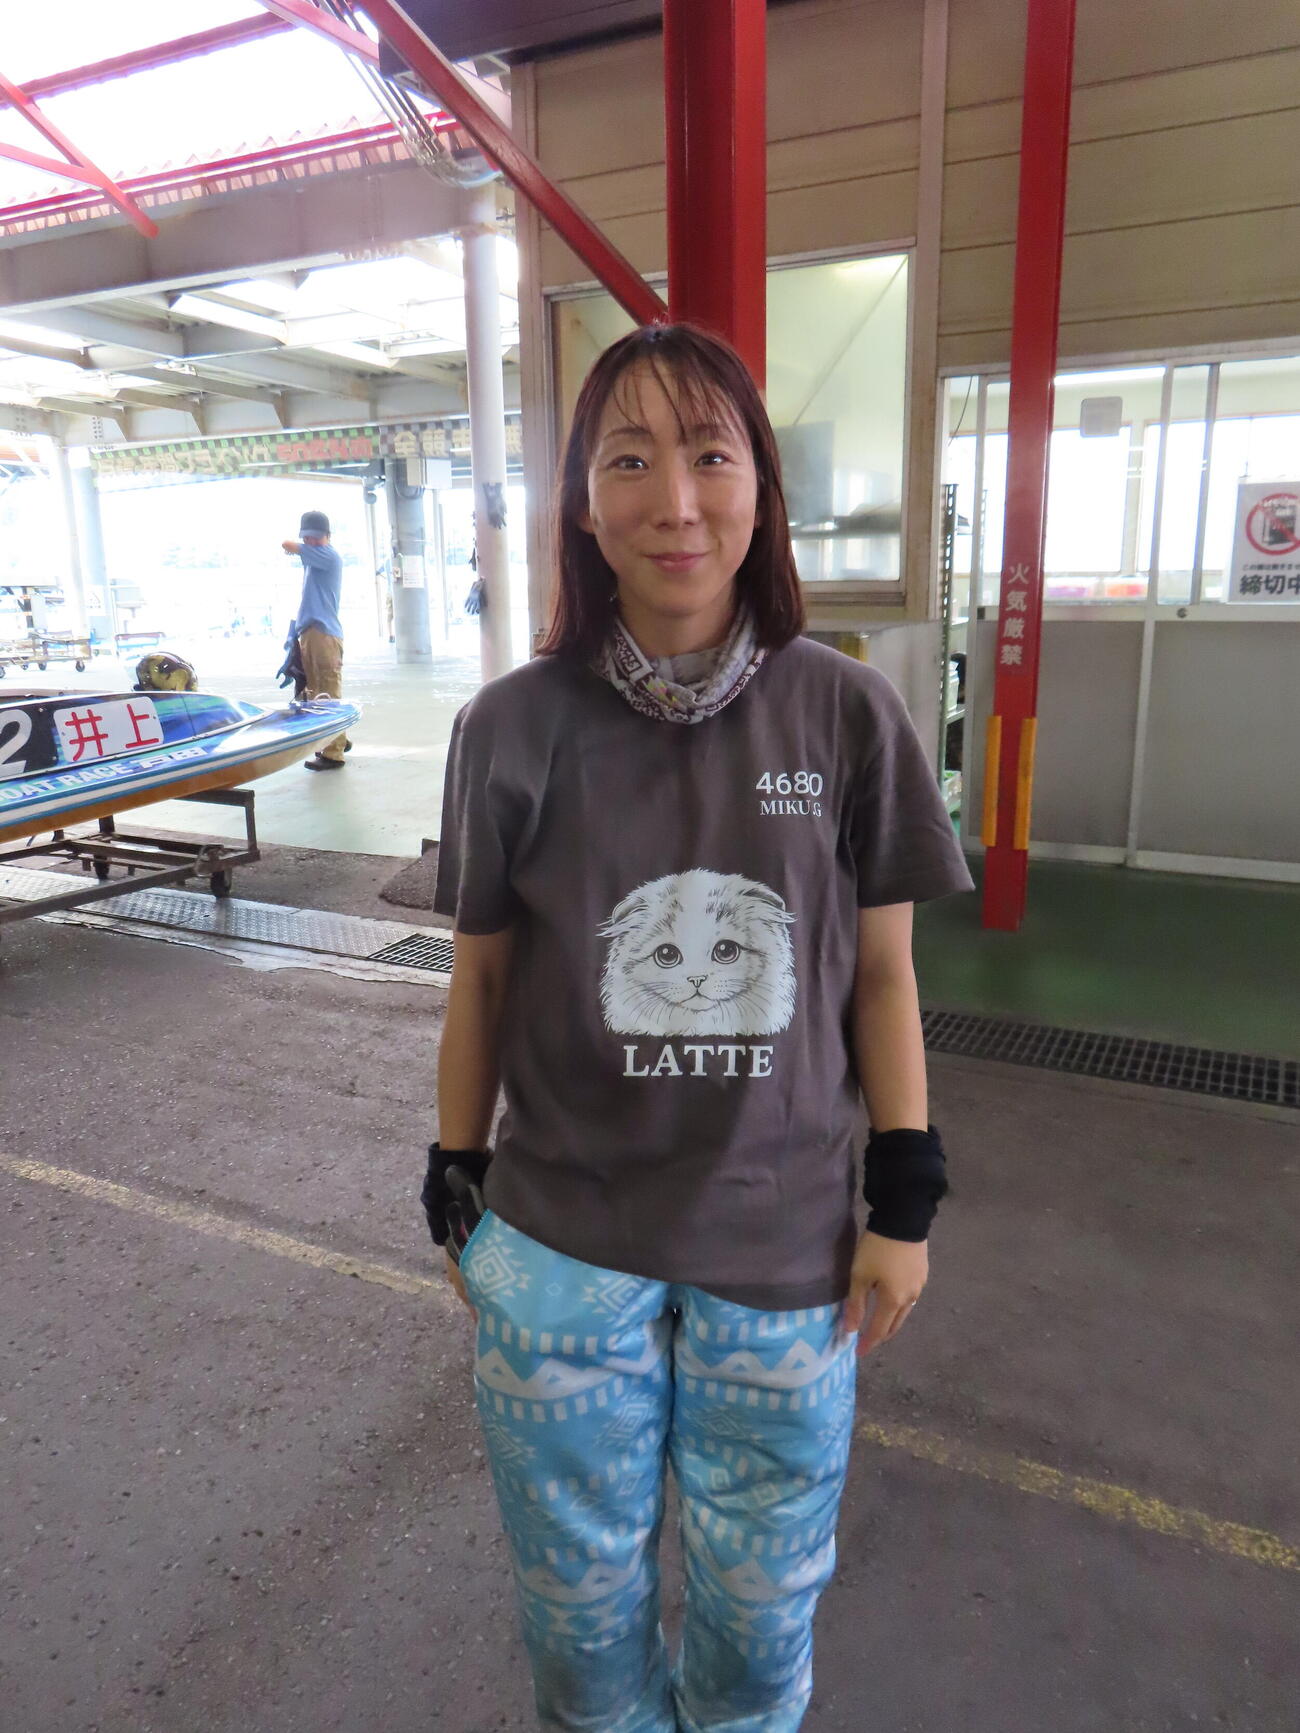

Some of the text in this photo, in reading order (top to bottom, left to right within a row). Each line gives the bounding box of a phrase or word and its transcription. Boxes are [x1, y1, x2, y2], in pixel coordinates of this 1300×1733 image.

[1001, 563, 1030, 665] 火気厳禁
[0, 709, 32, 776] 2
[65, 704, 159, 761] 井上
[56, 763, 133, 788] RACE
[756, 771, 823, 796] 4680
[623, 1045, 774, 1077] LATTE
